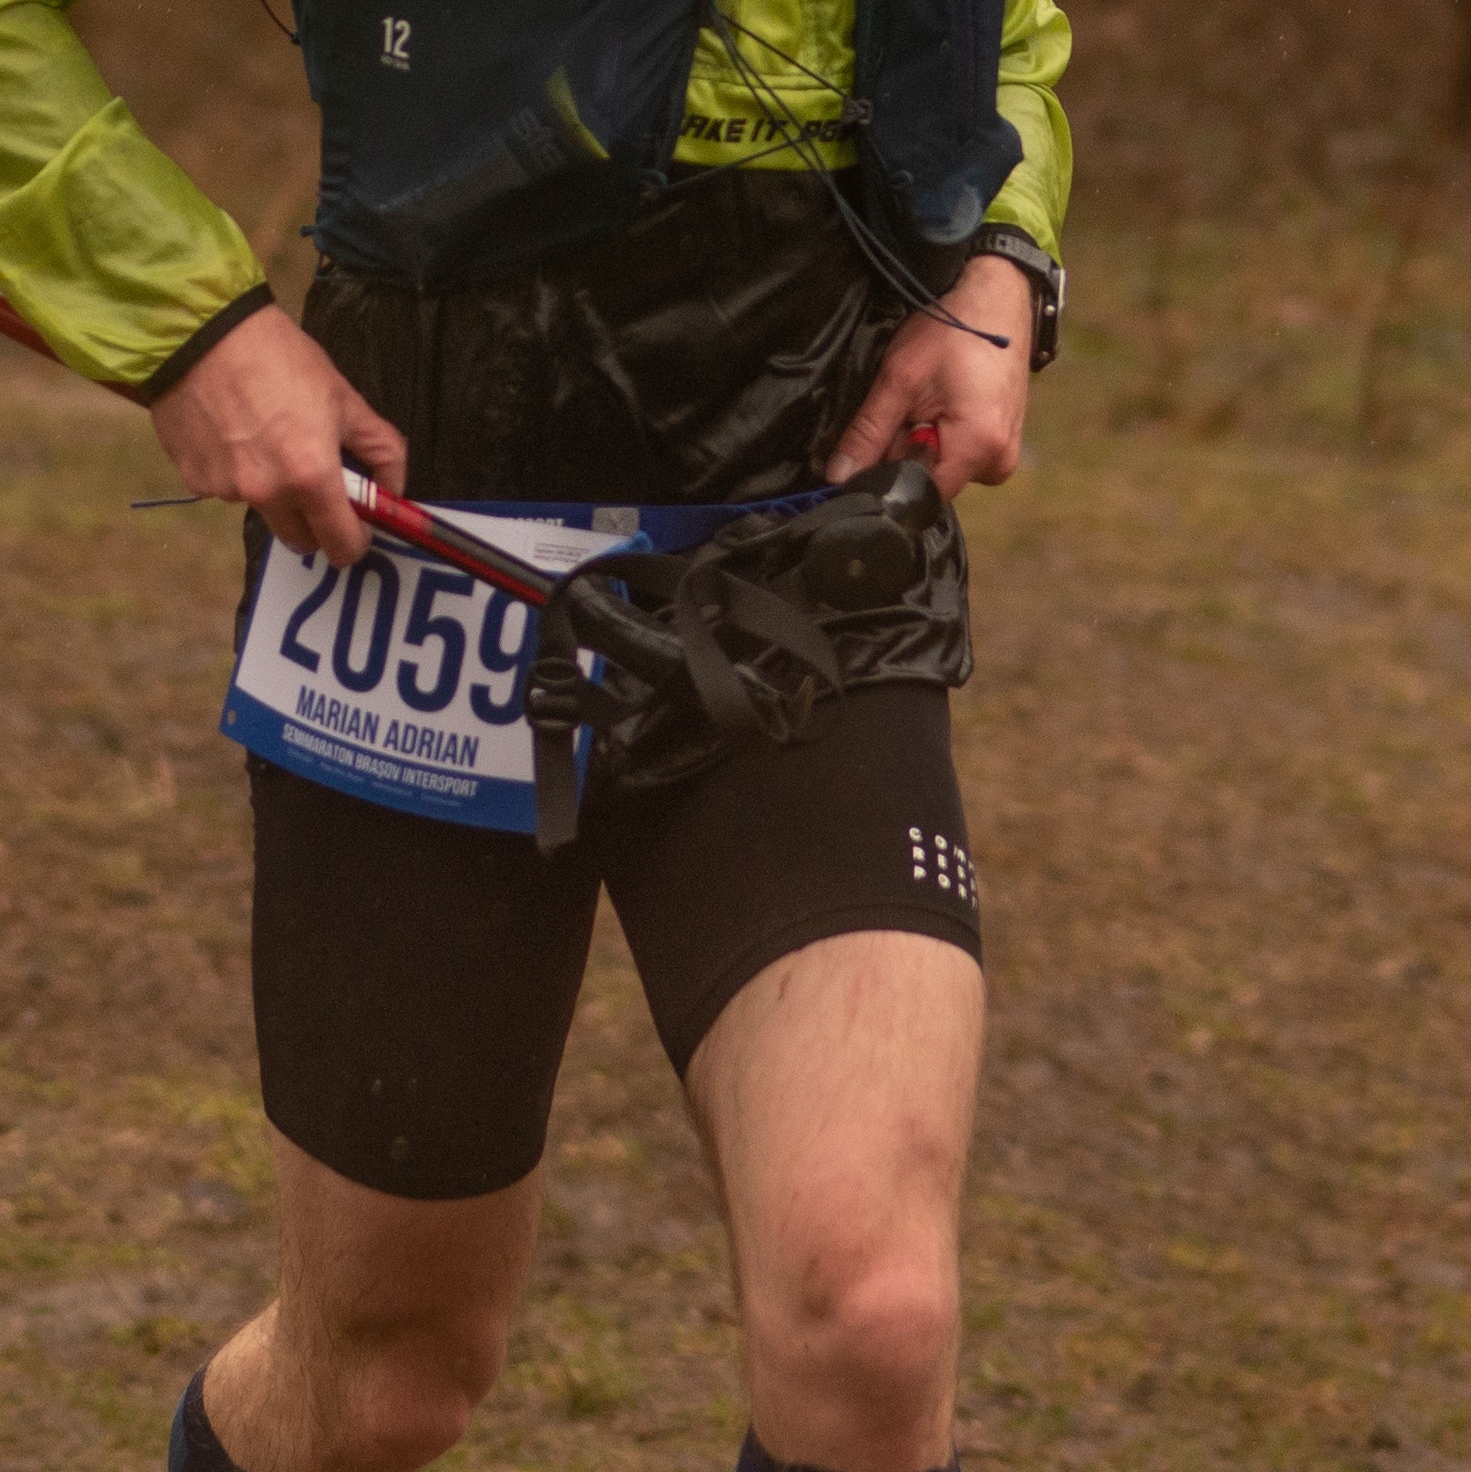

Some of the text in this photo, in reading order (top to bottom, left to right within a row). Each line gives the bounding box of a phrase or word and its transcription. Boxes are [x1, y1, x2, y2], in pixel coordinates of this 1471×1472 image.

[381, 16, 411, 59] 12
[280, 549, 540, 726] 2059
[281, 722, 355, 766] SEMIMARATON
[401, 766, 480, 798] INTERSPORT
[295, 684, 480, 768] MARIAN ADRIAN
